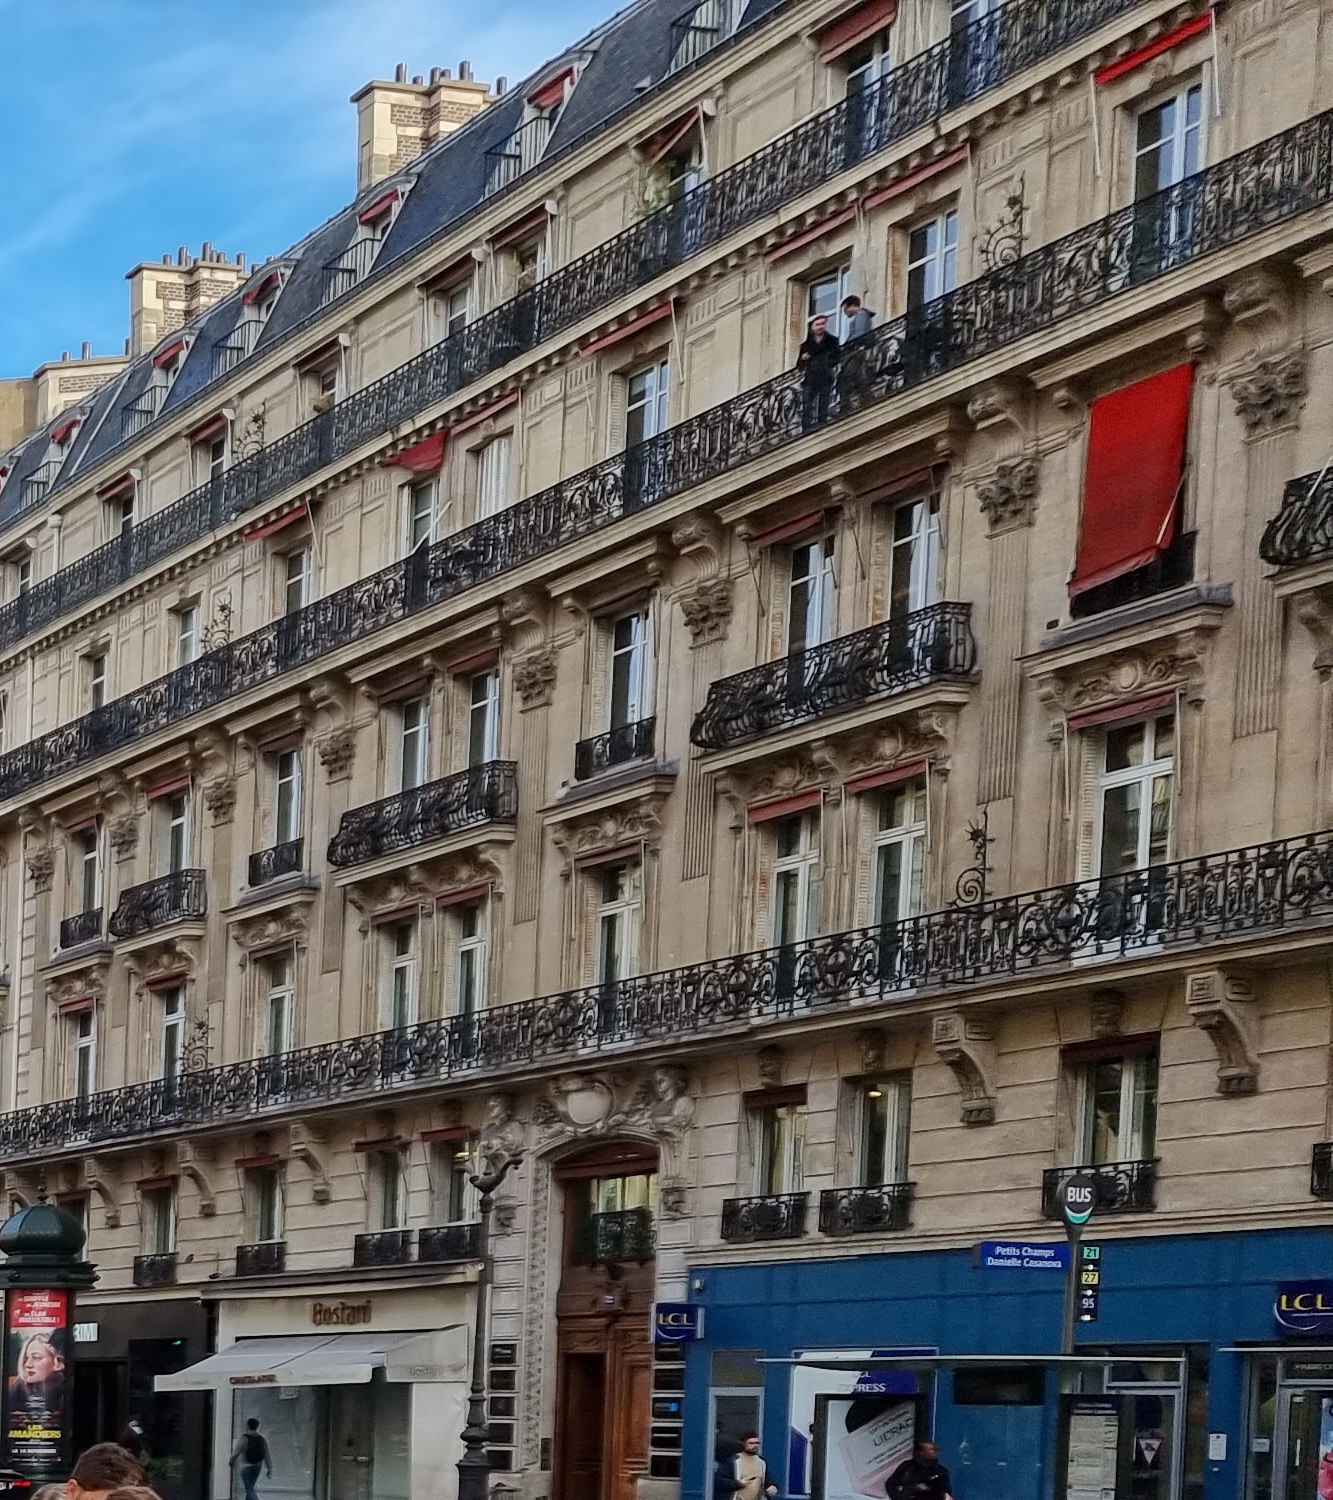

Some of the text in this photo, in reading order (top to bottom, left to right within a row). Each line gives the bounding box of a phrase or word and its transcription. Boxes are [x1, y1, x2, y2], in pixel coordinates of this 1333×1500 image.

[1067, 1187, 1092, 1203] BUS
[995, 1246, 1055, 1258] Petits Champs
[1086, 1249, 1097, 1257] 21
[987, 1257, 1022, 1267] Danielle
[1084, 1274, 1096, 1282] 27
[1082, 1298, 1095, 1309] 95
[1281, 1294, 1333, 1311] LCL
[659, 1313, 694, 1326] LCL
